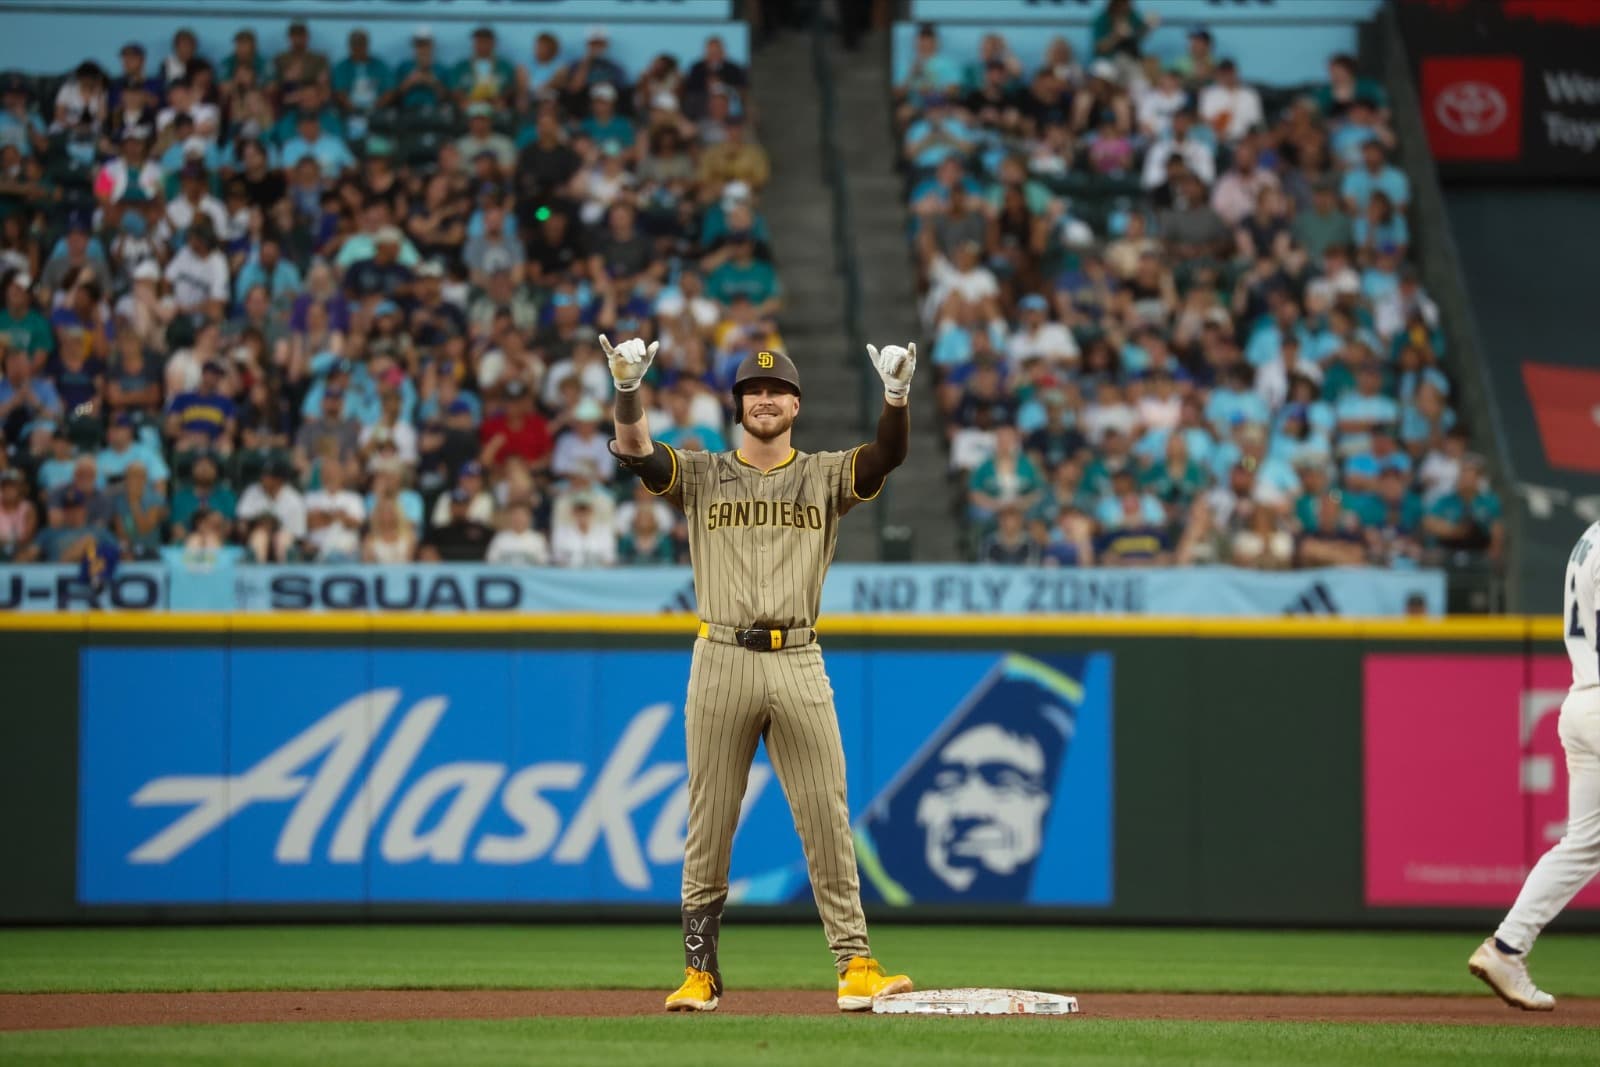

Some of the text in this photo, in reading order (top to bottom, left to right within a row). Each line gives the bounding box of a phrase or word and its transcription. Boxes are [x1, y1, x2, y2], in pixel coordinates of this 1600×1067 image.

[758, 352, 774, 369] SD
[0, 574, 523, 611] J-RO SQUAD
[852, 575, 1146, 611] NO FLY ZONE
